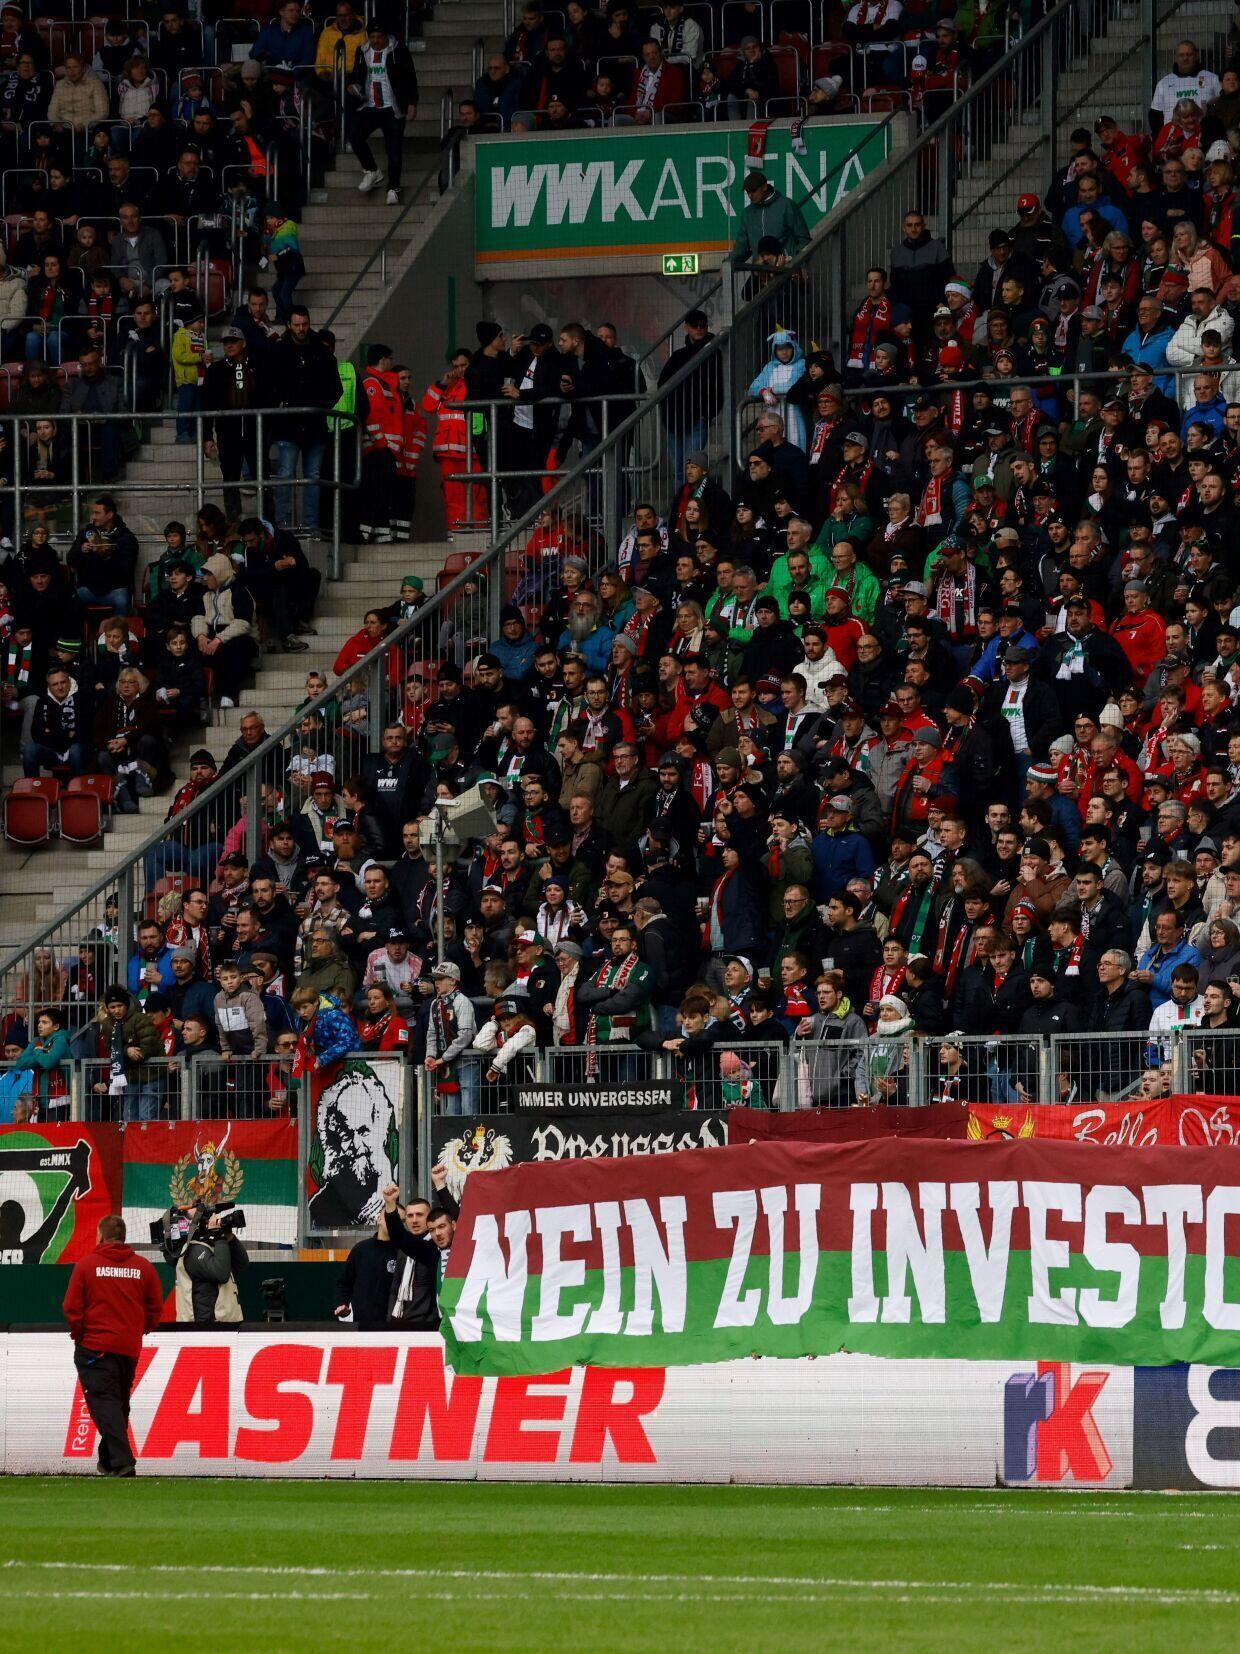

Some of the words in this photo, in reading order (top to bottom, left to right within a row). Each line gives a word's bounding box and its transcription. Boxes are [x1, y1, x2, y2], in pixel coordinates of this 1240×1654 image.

[1176, 89, 1199, 99] WWK
[490, 159, 647, 228] WWK
[519, 1091, 564, 1107] IMMER
[568, 1090, 672, 1106] UNVERGESSEN
[449, 1196, 688, 1342] NEIN
[711, 1183, 821, 1328] ZU
[96, 1267, 141, 1279] RASENHELFER
